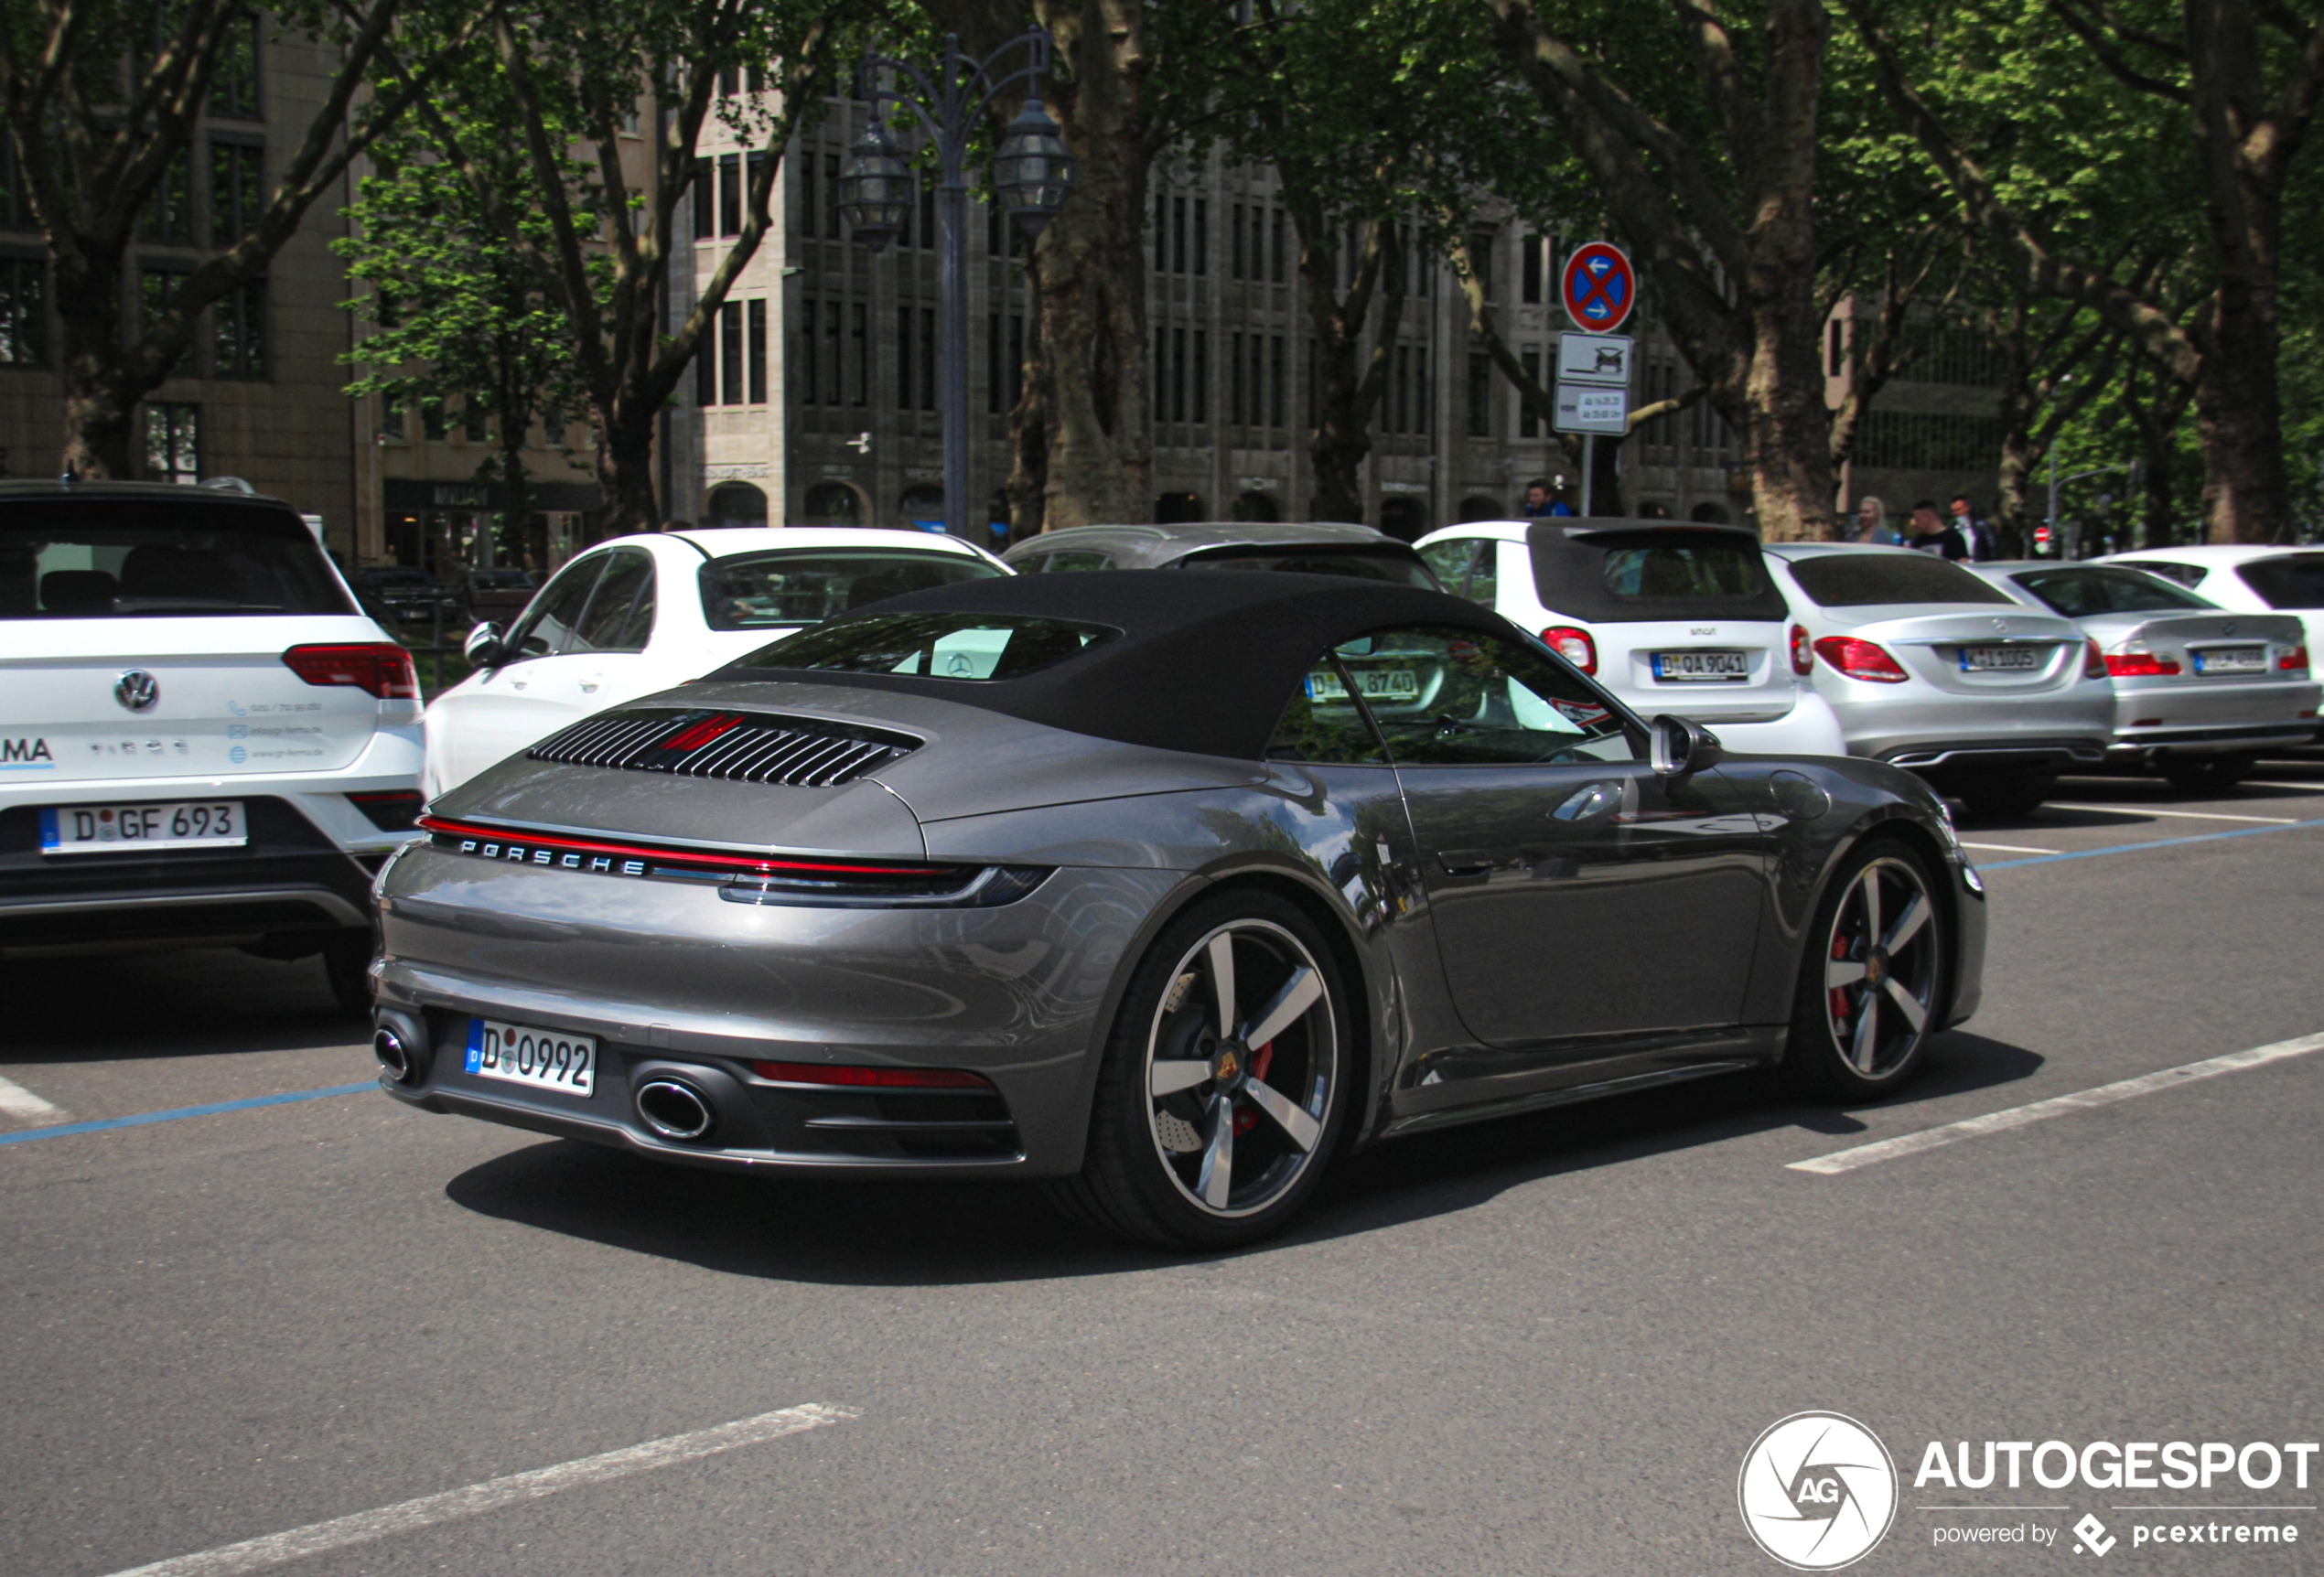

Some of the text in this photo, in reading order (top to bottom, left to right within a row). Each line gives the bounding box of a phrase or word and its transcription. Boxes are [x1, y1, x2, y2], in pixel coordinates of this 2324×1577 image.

[0, 737, 54, 763] MA
[74, 805, 231, 842] D GF 693
[461, 840, 645, 876] PORSCHE
[470, 1050, 478, 1063] D
[482, 1027, 500, 1069] D
